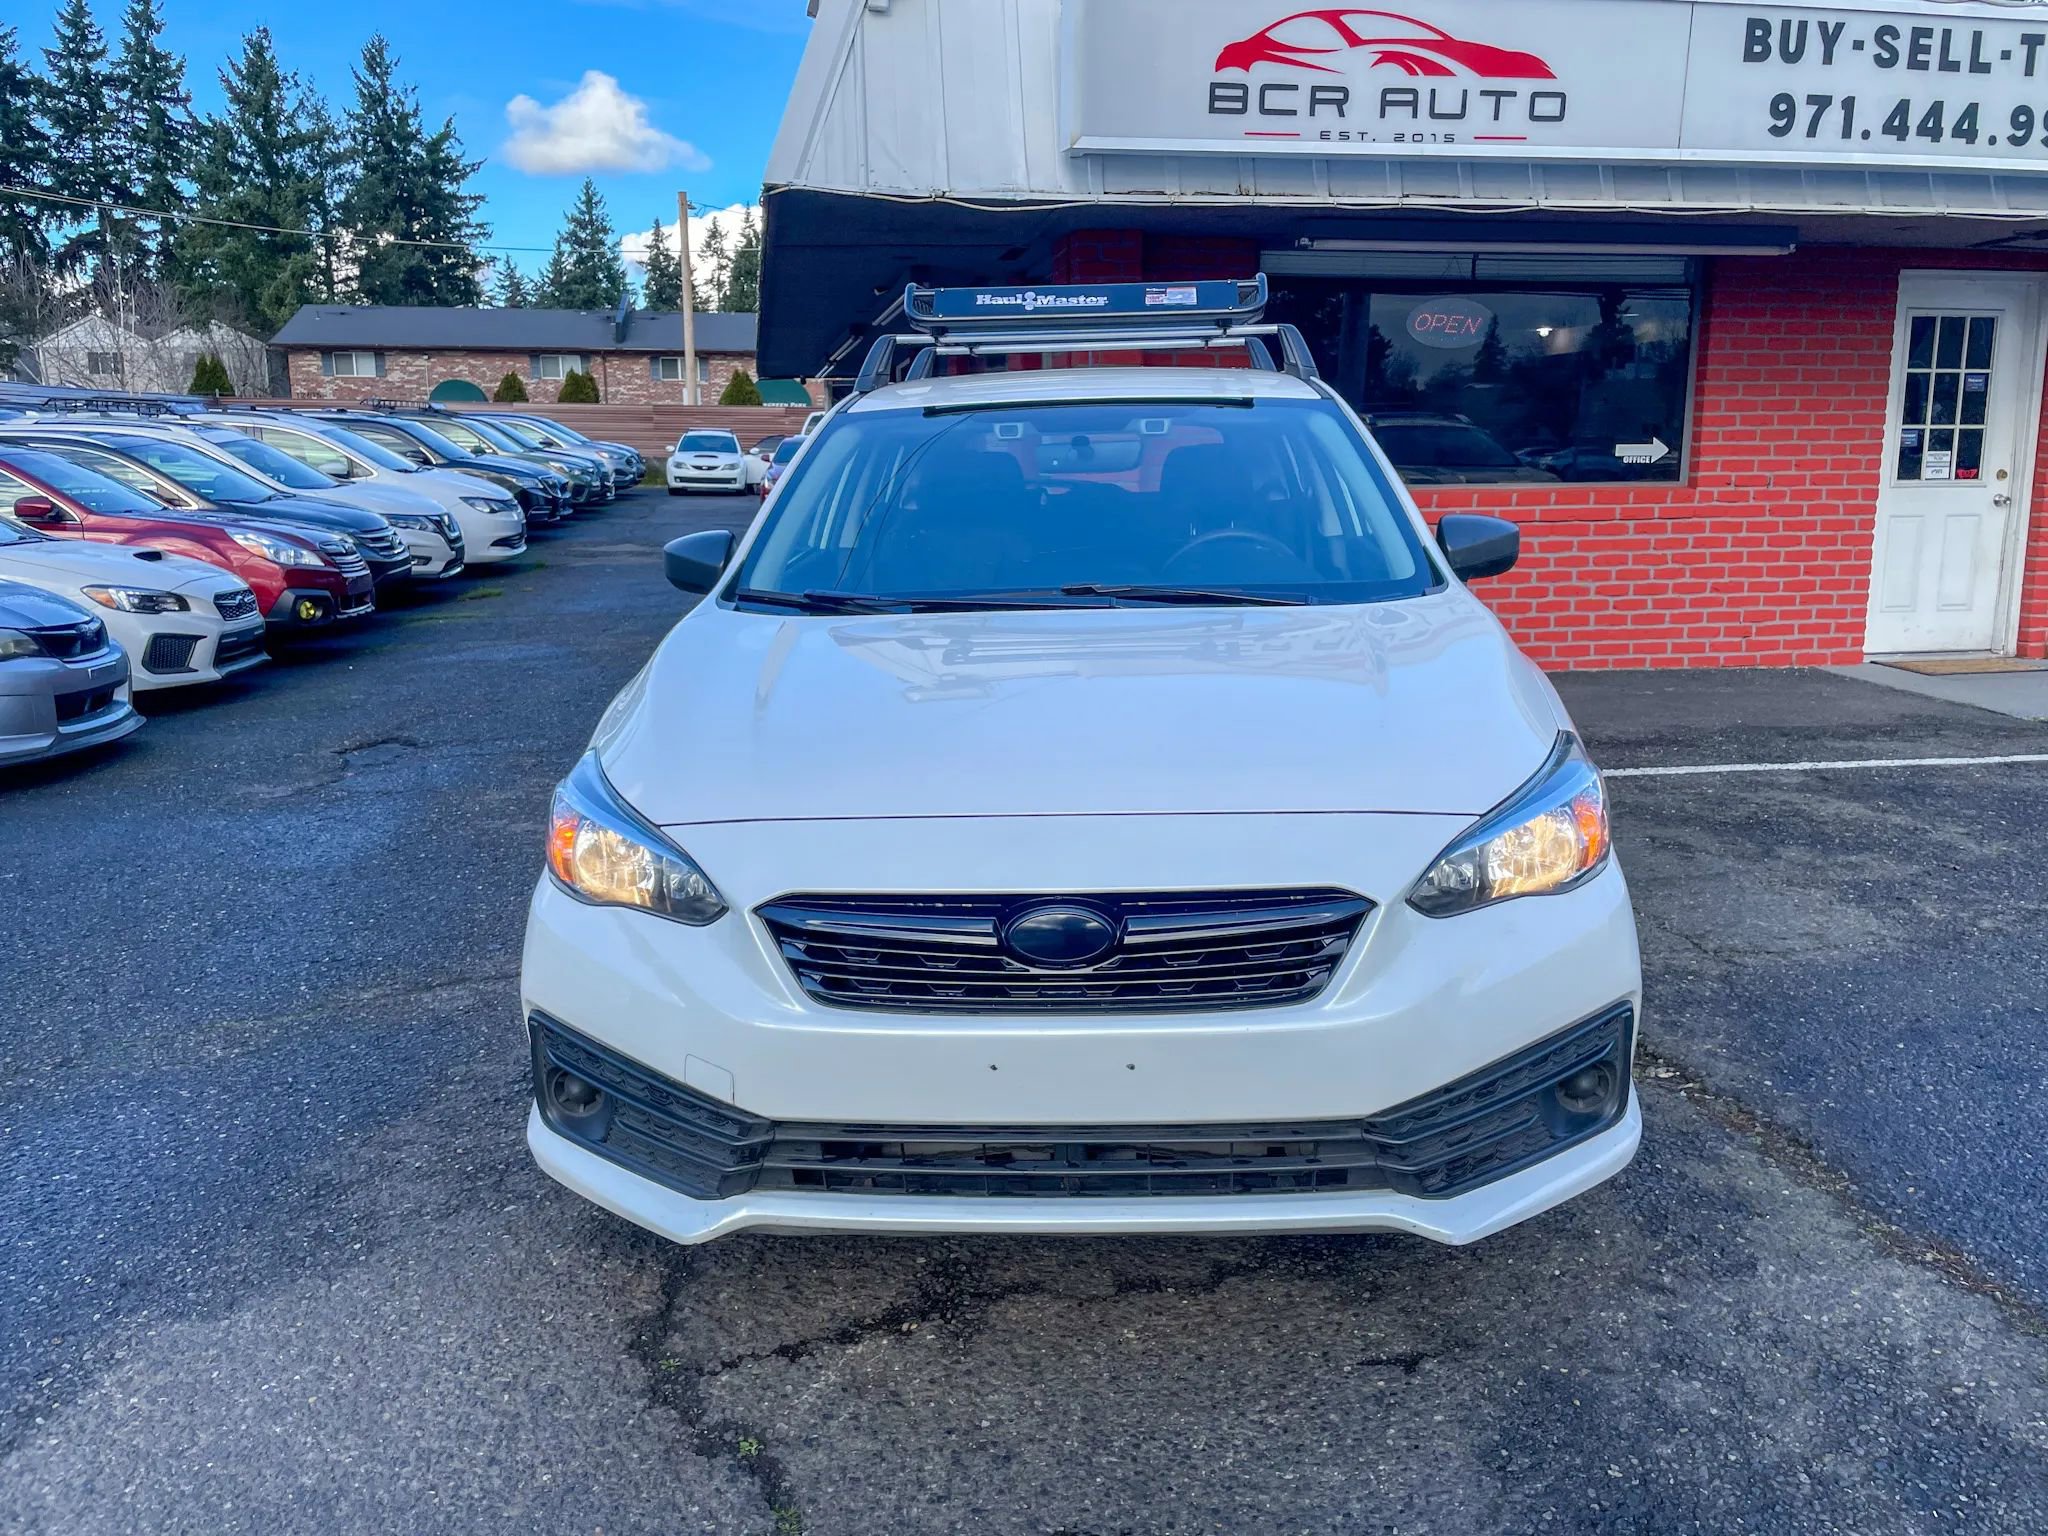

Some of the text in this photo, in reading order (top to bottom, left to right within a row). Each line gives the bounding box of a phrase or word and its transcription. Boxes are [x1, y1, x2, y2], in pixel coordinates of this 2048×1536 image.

[1208, 82, 1567, 122] BCR AUTO
[1767, 92, 2048, 149] 971.444.9
[1319, 130, 1456, 143] EST. 2015
[976, 293, 1023, 305] Haul
[1415, 313, 1482, 334] OPEN
[1623, 455, 1651, 464] OFFICE
